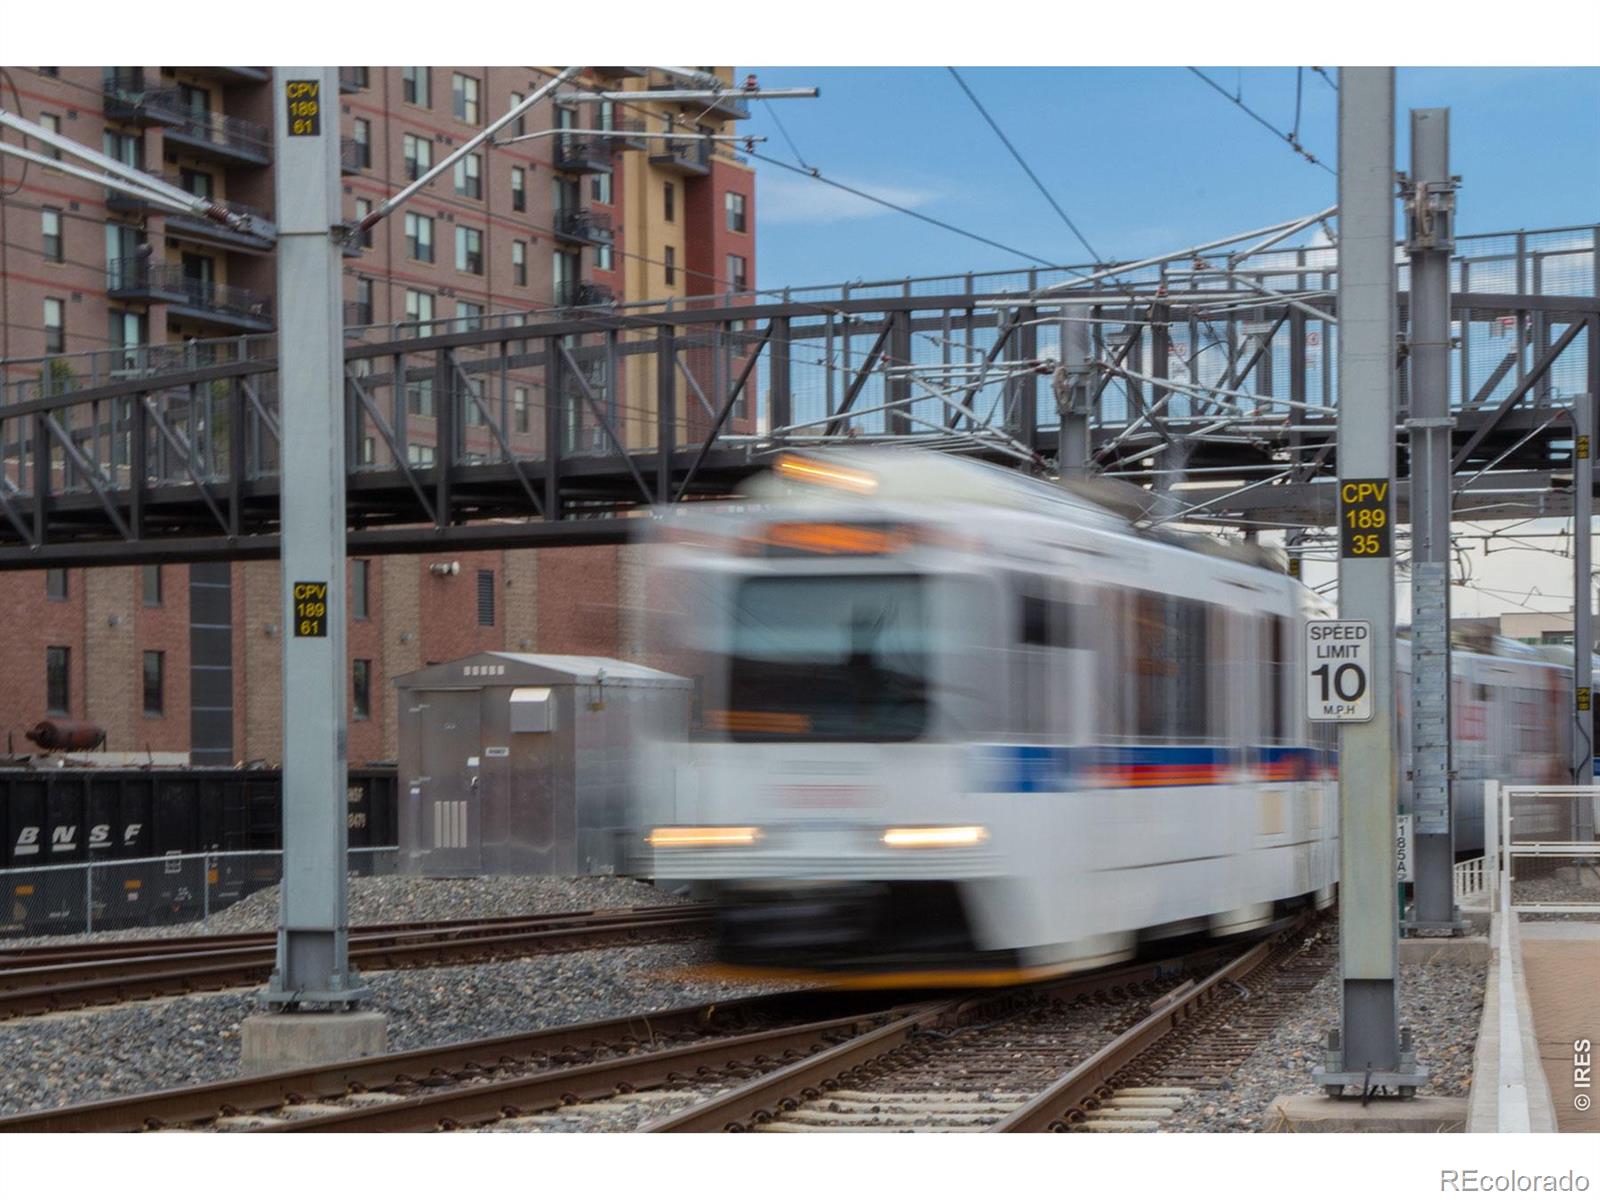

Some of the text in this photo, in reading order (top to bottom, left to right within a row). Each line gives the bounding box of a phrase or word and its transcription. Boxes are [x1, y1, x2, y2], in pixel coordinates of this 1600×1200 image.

[287, 83, 318, 98] CPV
[291, 101, 317, 116] 189
[1342, 483, 1388, 503] CPV
[1347, 509, 1386, 528] 189
[1352, 534, 1380, 554] 35
[295, 584, 326, 599] CPV
[297, 603, 325, 617] 189
[301, 620, 318, 635] 61
[1310, 626, 1368, 640] SPEED
[1316, 645, 1360, 658] LIMIT
[1311, 663, 1366, 702] 10
[16, 824, 142, 847] BNSF
